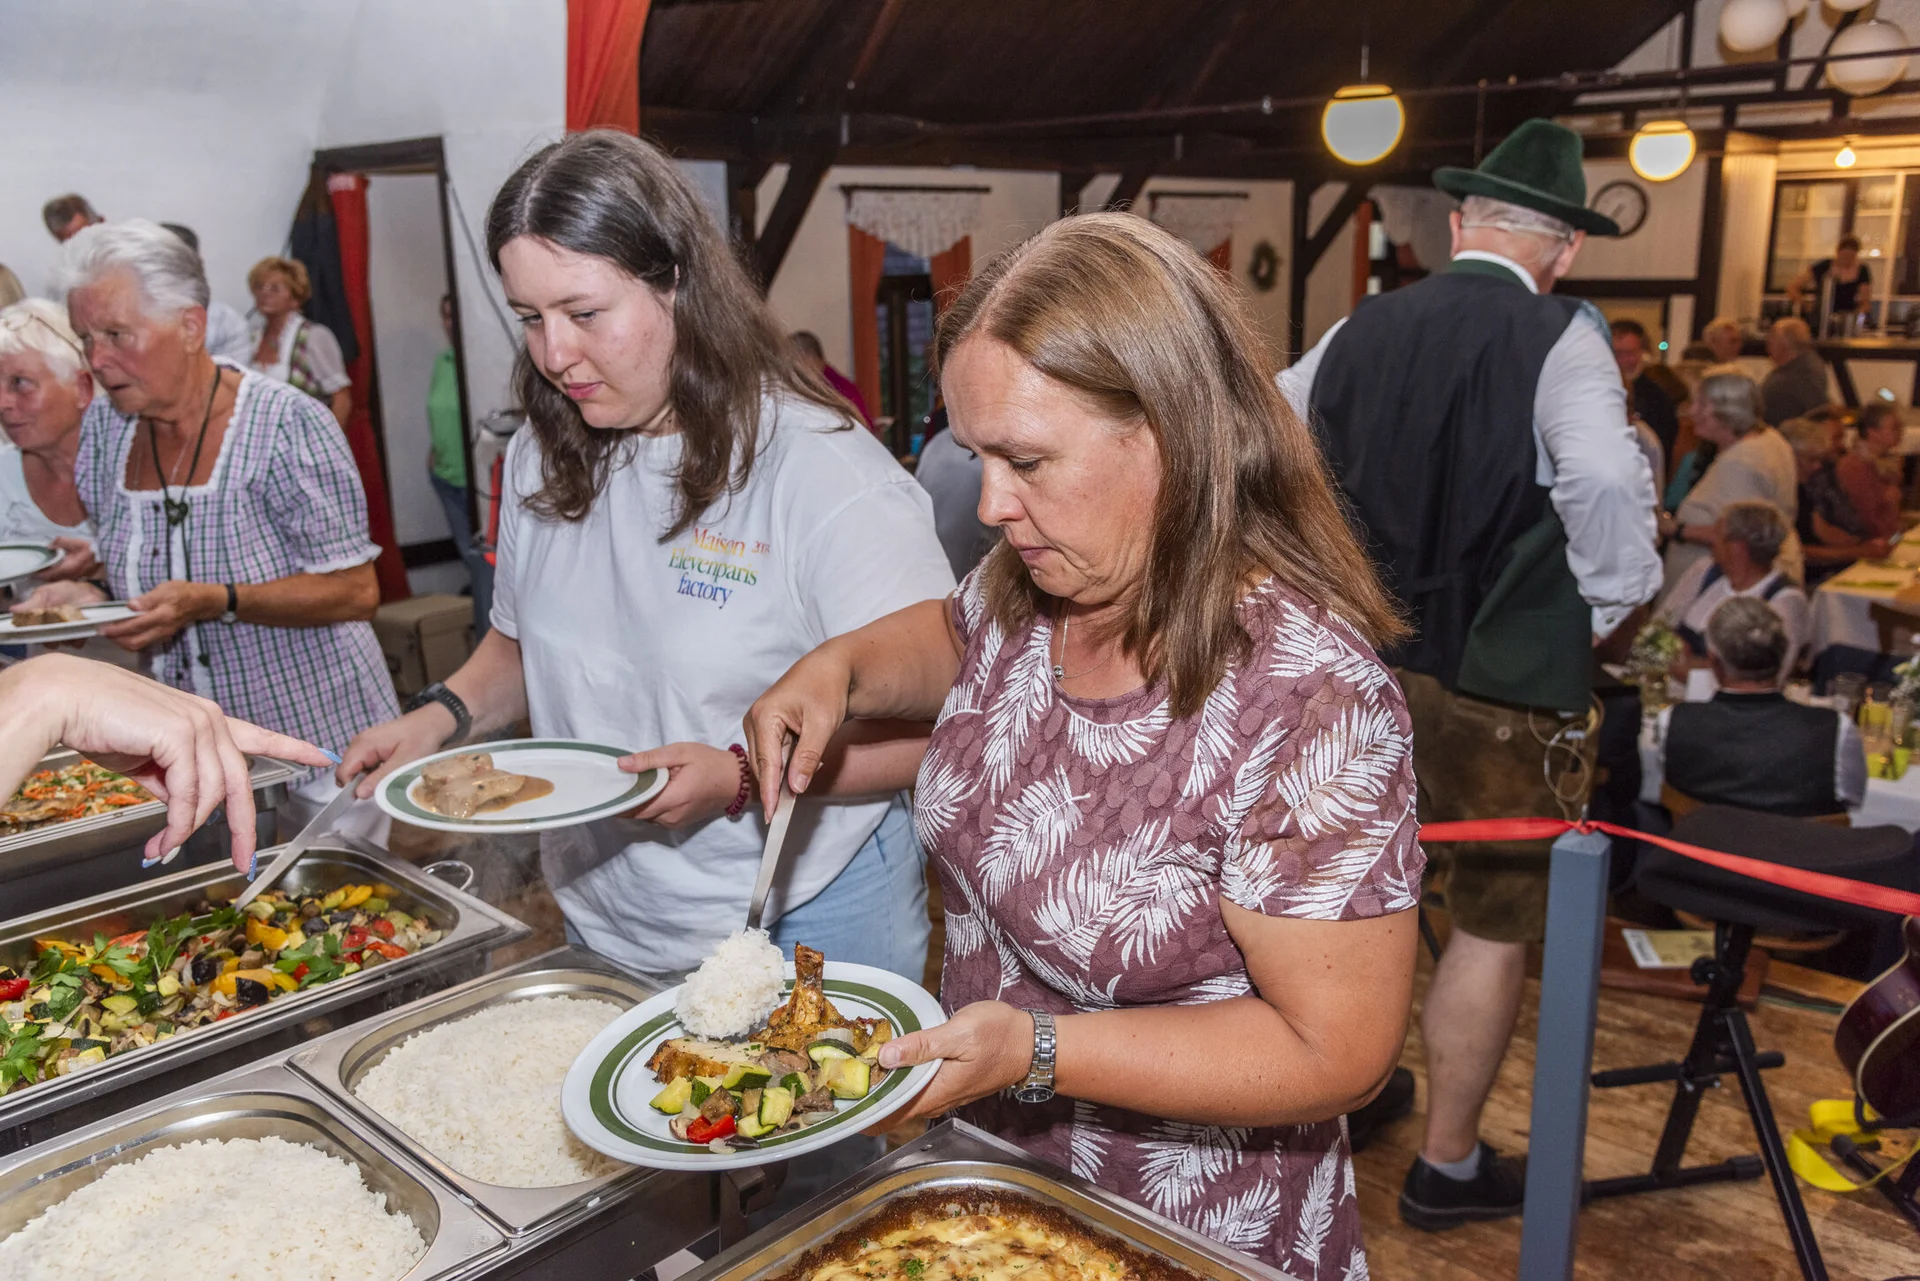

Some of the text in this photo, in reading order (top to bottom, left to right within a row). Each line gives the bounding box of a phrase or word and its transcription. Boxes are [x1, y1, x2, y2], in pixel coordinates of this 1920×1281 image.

[690, 527, 746, 557] Maison
[668, 547, 759, 586] Elevenparis
[676, 571, 733, 610] factory
